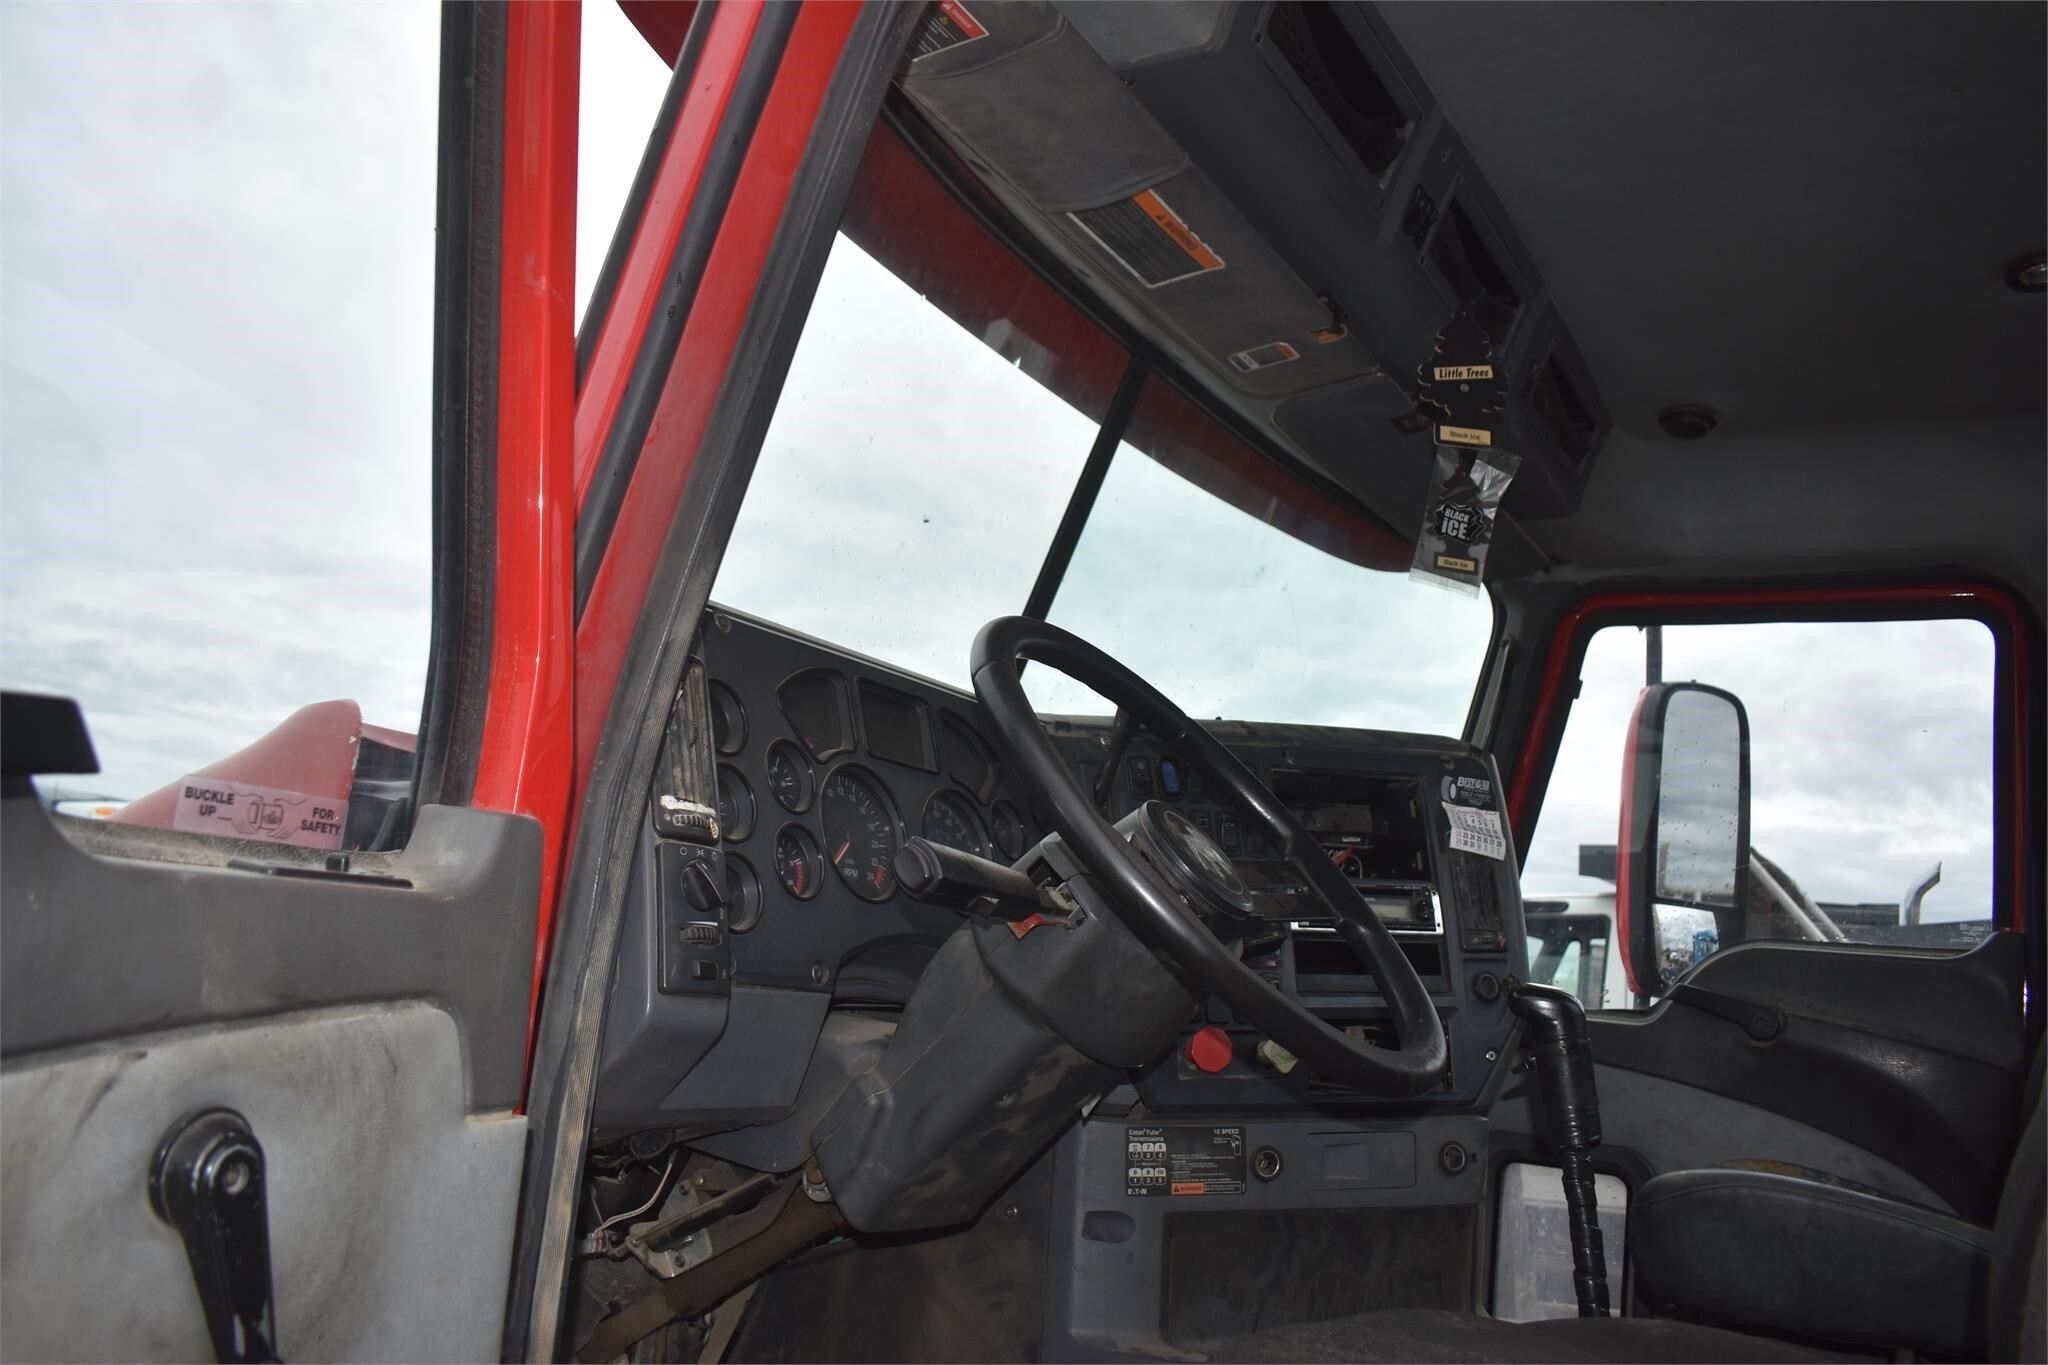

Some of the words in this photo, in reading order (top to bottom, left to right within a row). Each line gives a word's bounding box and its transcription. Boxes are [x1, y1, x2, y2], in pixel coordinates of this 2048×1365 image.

[1439, 367, 1463, 379] Little
[1466, 366, 1489, 378] Trees
[1445, 508, 1470, 522] BLACK
[184, 786, 235, 806] BUCKLE
[199, 805, 217, 818] UP
[312, 807, 335, 821] FOR
[301, 820, 342, 836] SAFETY
